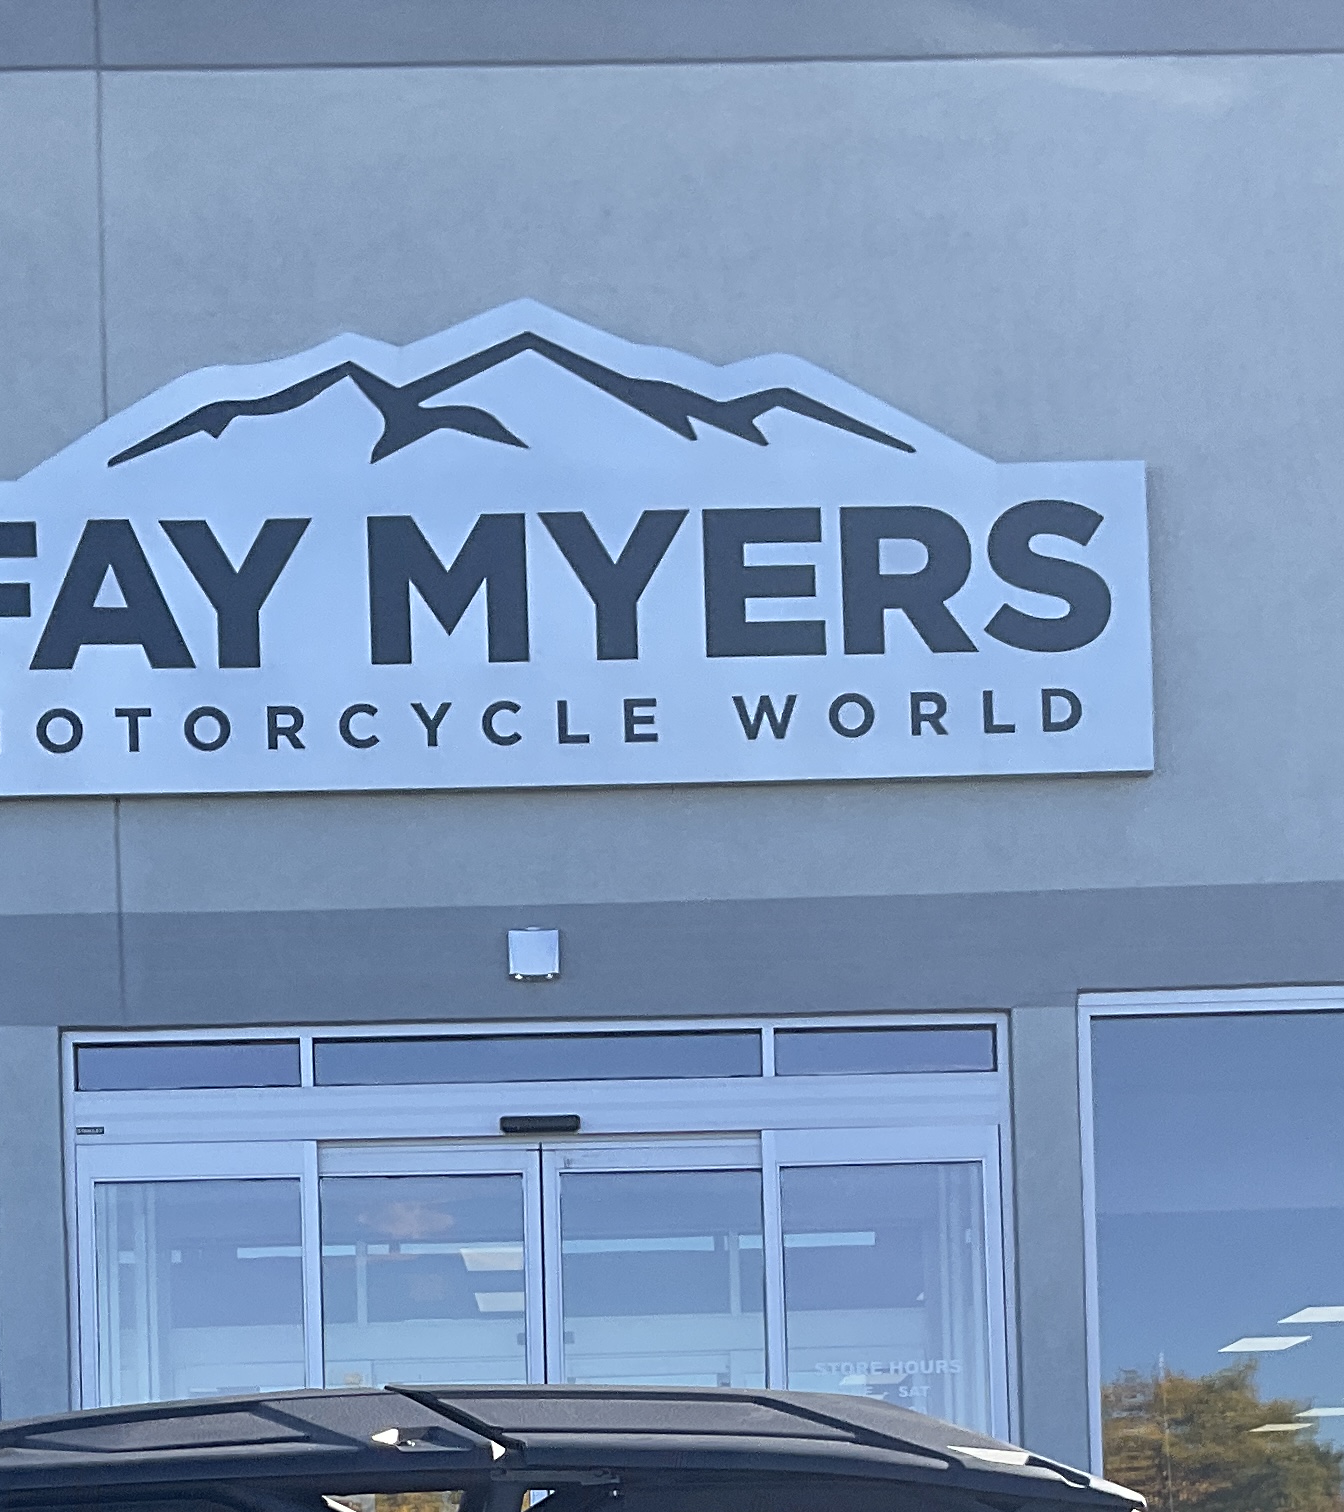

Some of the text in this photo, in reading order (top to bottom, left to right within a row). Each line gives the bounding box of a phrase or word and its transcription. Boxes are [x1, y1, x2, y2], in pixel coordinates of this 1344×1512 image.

[367, 498, 1113, 667] MYERS
[732, 687, 1084, 743] WORLD
[814, 1359, 963, 1376] STORE HOURS
[898, 1385, 931, 1398] SAT
